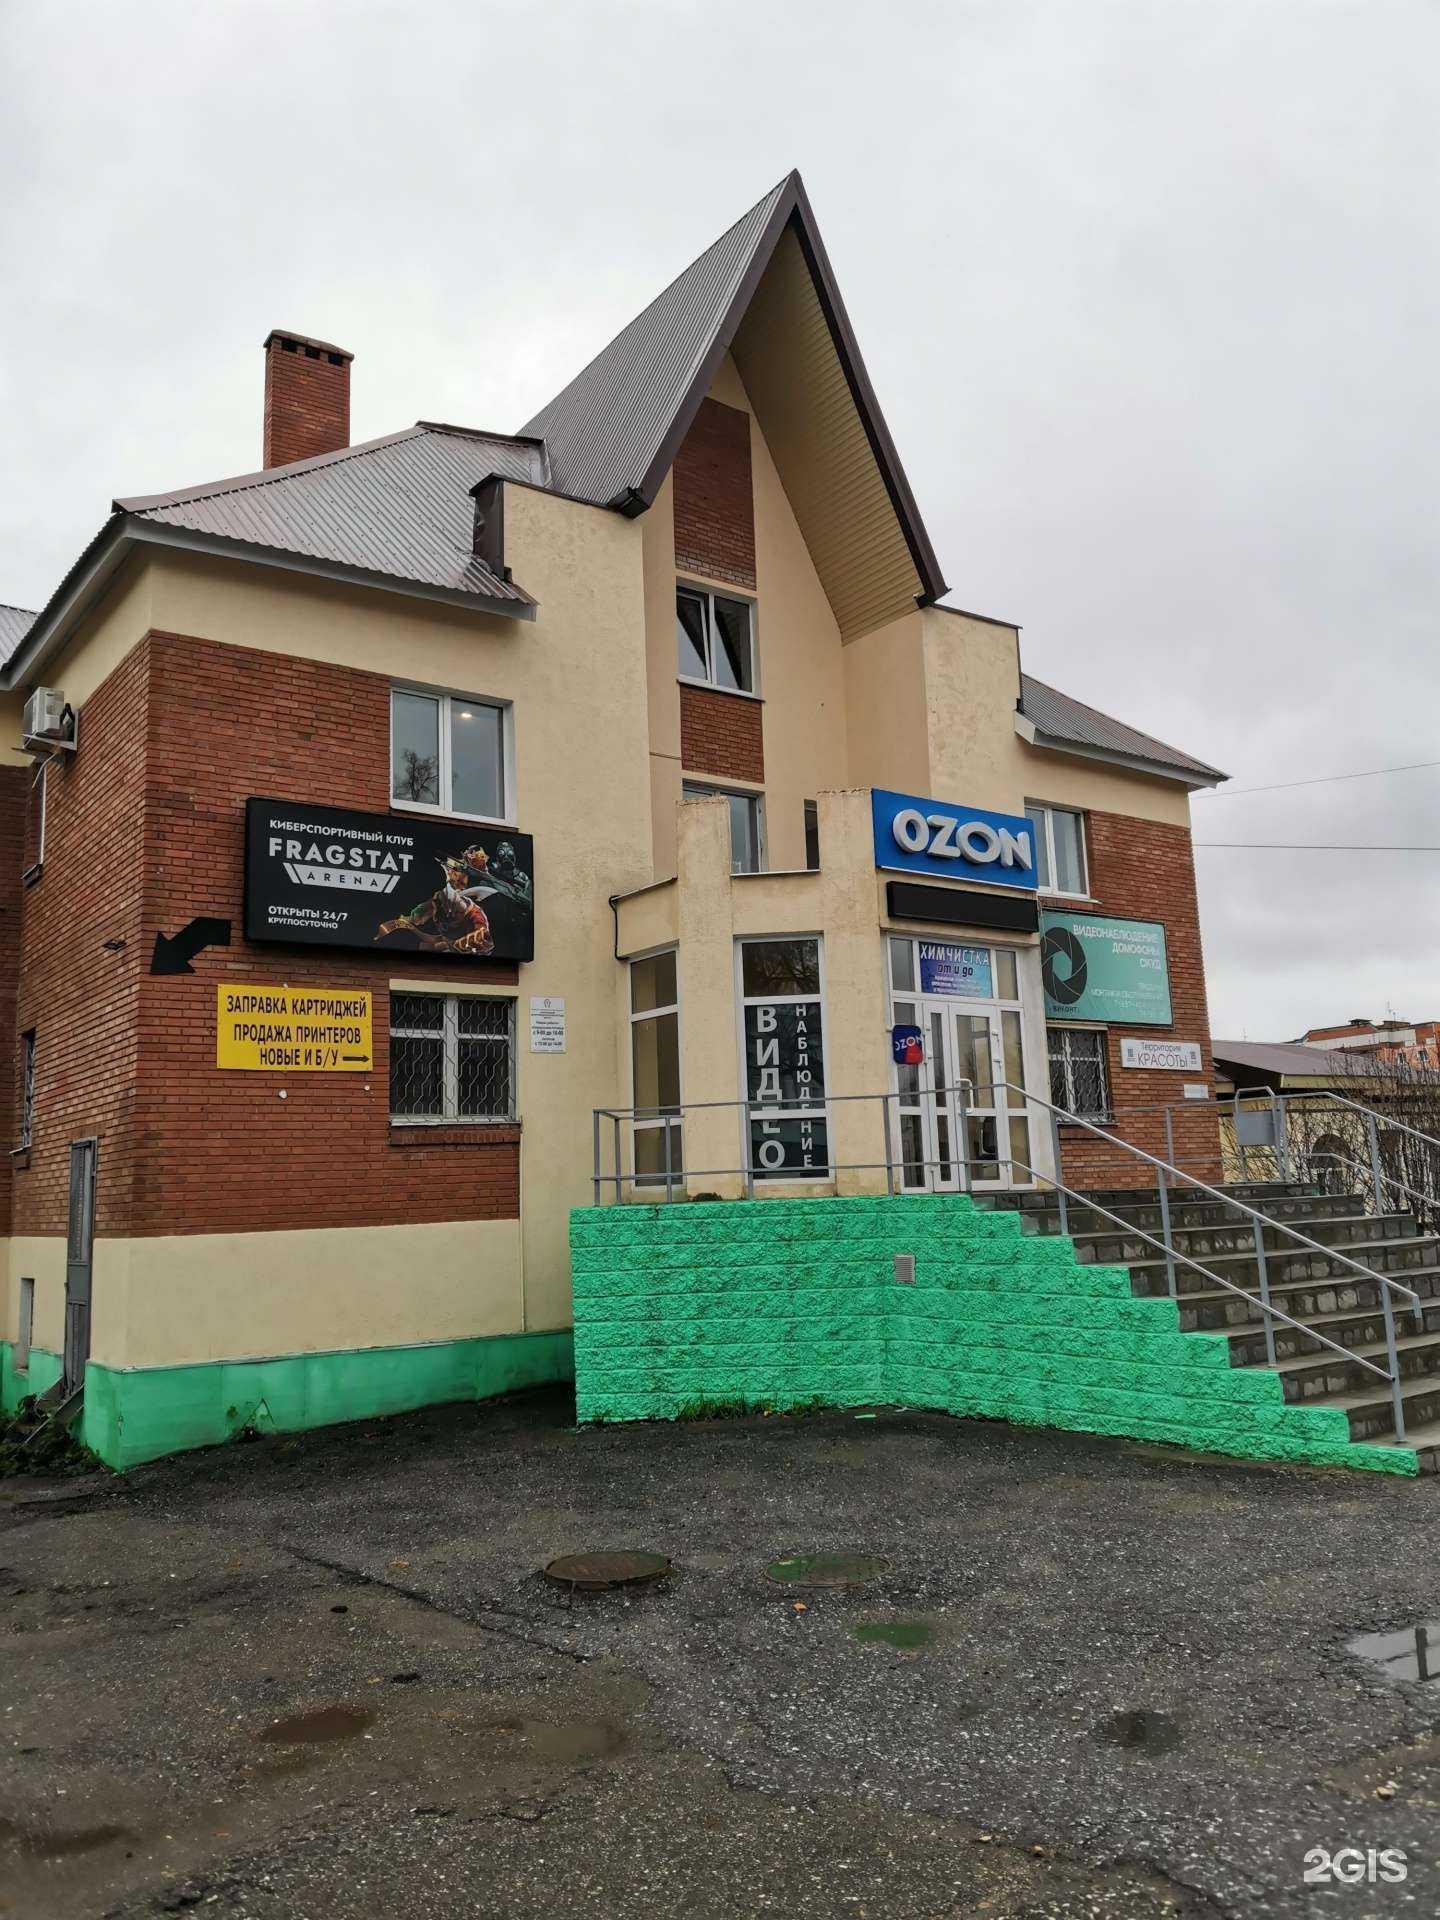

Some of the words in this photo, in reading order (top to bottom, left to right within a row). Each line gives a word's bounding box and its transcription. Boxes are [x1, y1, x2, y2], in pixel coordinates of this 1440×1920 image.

[269, 819, 383, 843] КИБЕРСПОРТИВНЫЙ
[385, 834, 414, 846] КЛУБ
[893, 808, 1032, 870] OZON
[269, 837, 414, 872] FRAGSTAT
[307, 872, 378, 887] ARENA
[268, 905, 320, 918] ОТКРЫТЫ
[322, 910, 348, 921] 24/7
[268, 917, 338, 929] КРУГЛОСУТОЧНО
[1073, 924, 1159, 943] ВИДЕОНАБЛЮДЕНИЕ
[920, 944, 990, 966] ХИМЧИСТКА
[227, 995, 287, 1014] ЗАПРАВКА
[292, 996, 367, 1020] КАРТРИДЖЕЙ
[234, 1024, 292, 1045] ПРОДАЖА
[296, 1026, 361, 1044] ПРИНТЕРОВ
[260, 1048, 301, 1066] НОВЫЕ
[304, 1048, 313, 1066] И
[315, 1047, 339, 1068] Б/У
[1138, 1052, 1188, 1068] КРАСОТЫ
